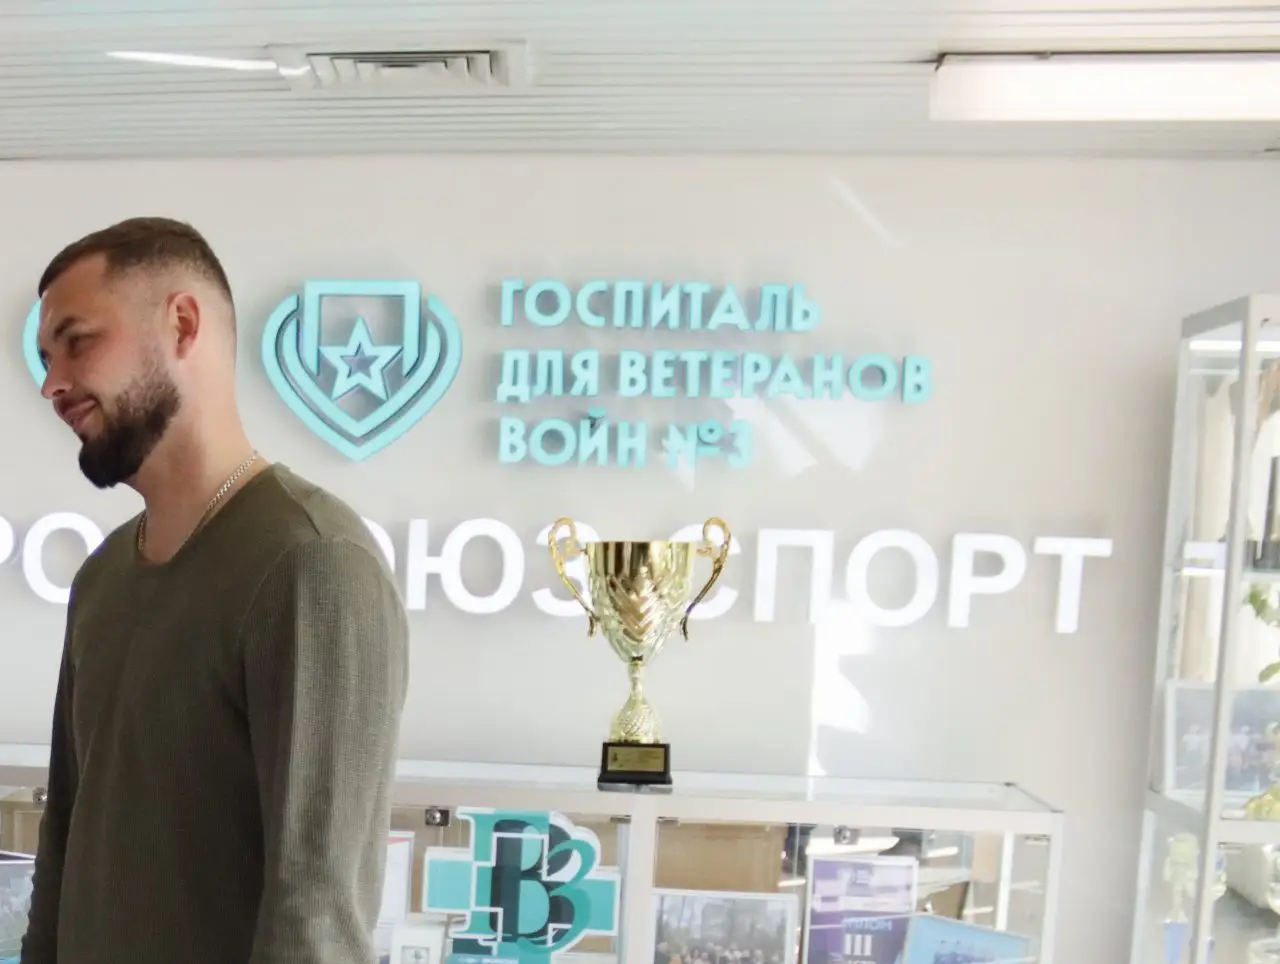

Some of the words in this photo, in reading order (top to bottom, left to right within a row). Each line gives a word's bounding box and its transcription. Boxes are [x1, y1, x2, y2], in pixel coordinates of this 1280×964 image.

[499, 277, 821, 333] ГОСПИТАЛЬ
[496, 348, 600, 404] ДЛЯ
[620, 349, 934, 404] ВЕТЕРАНОВ
[498, 407, 648, 467] ВОЙН
